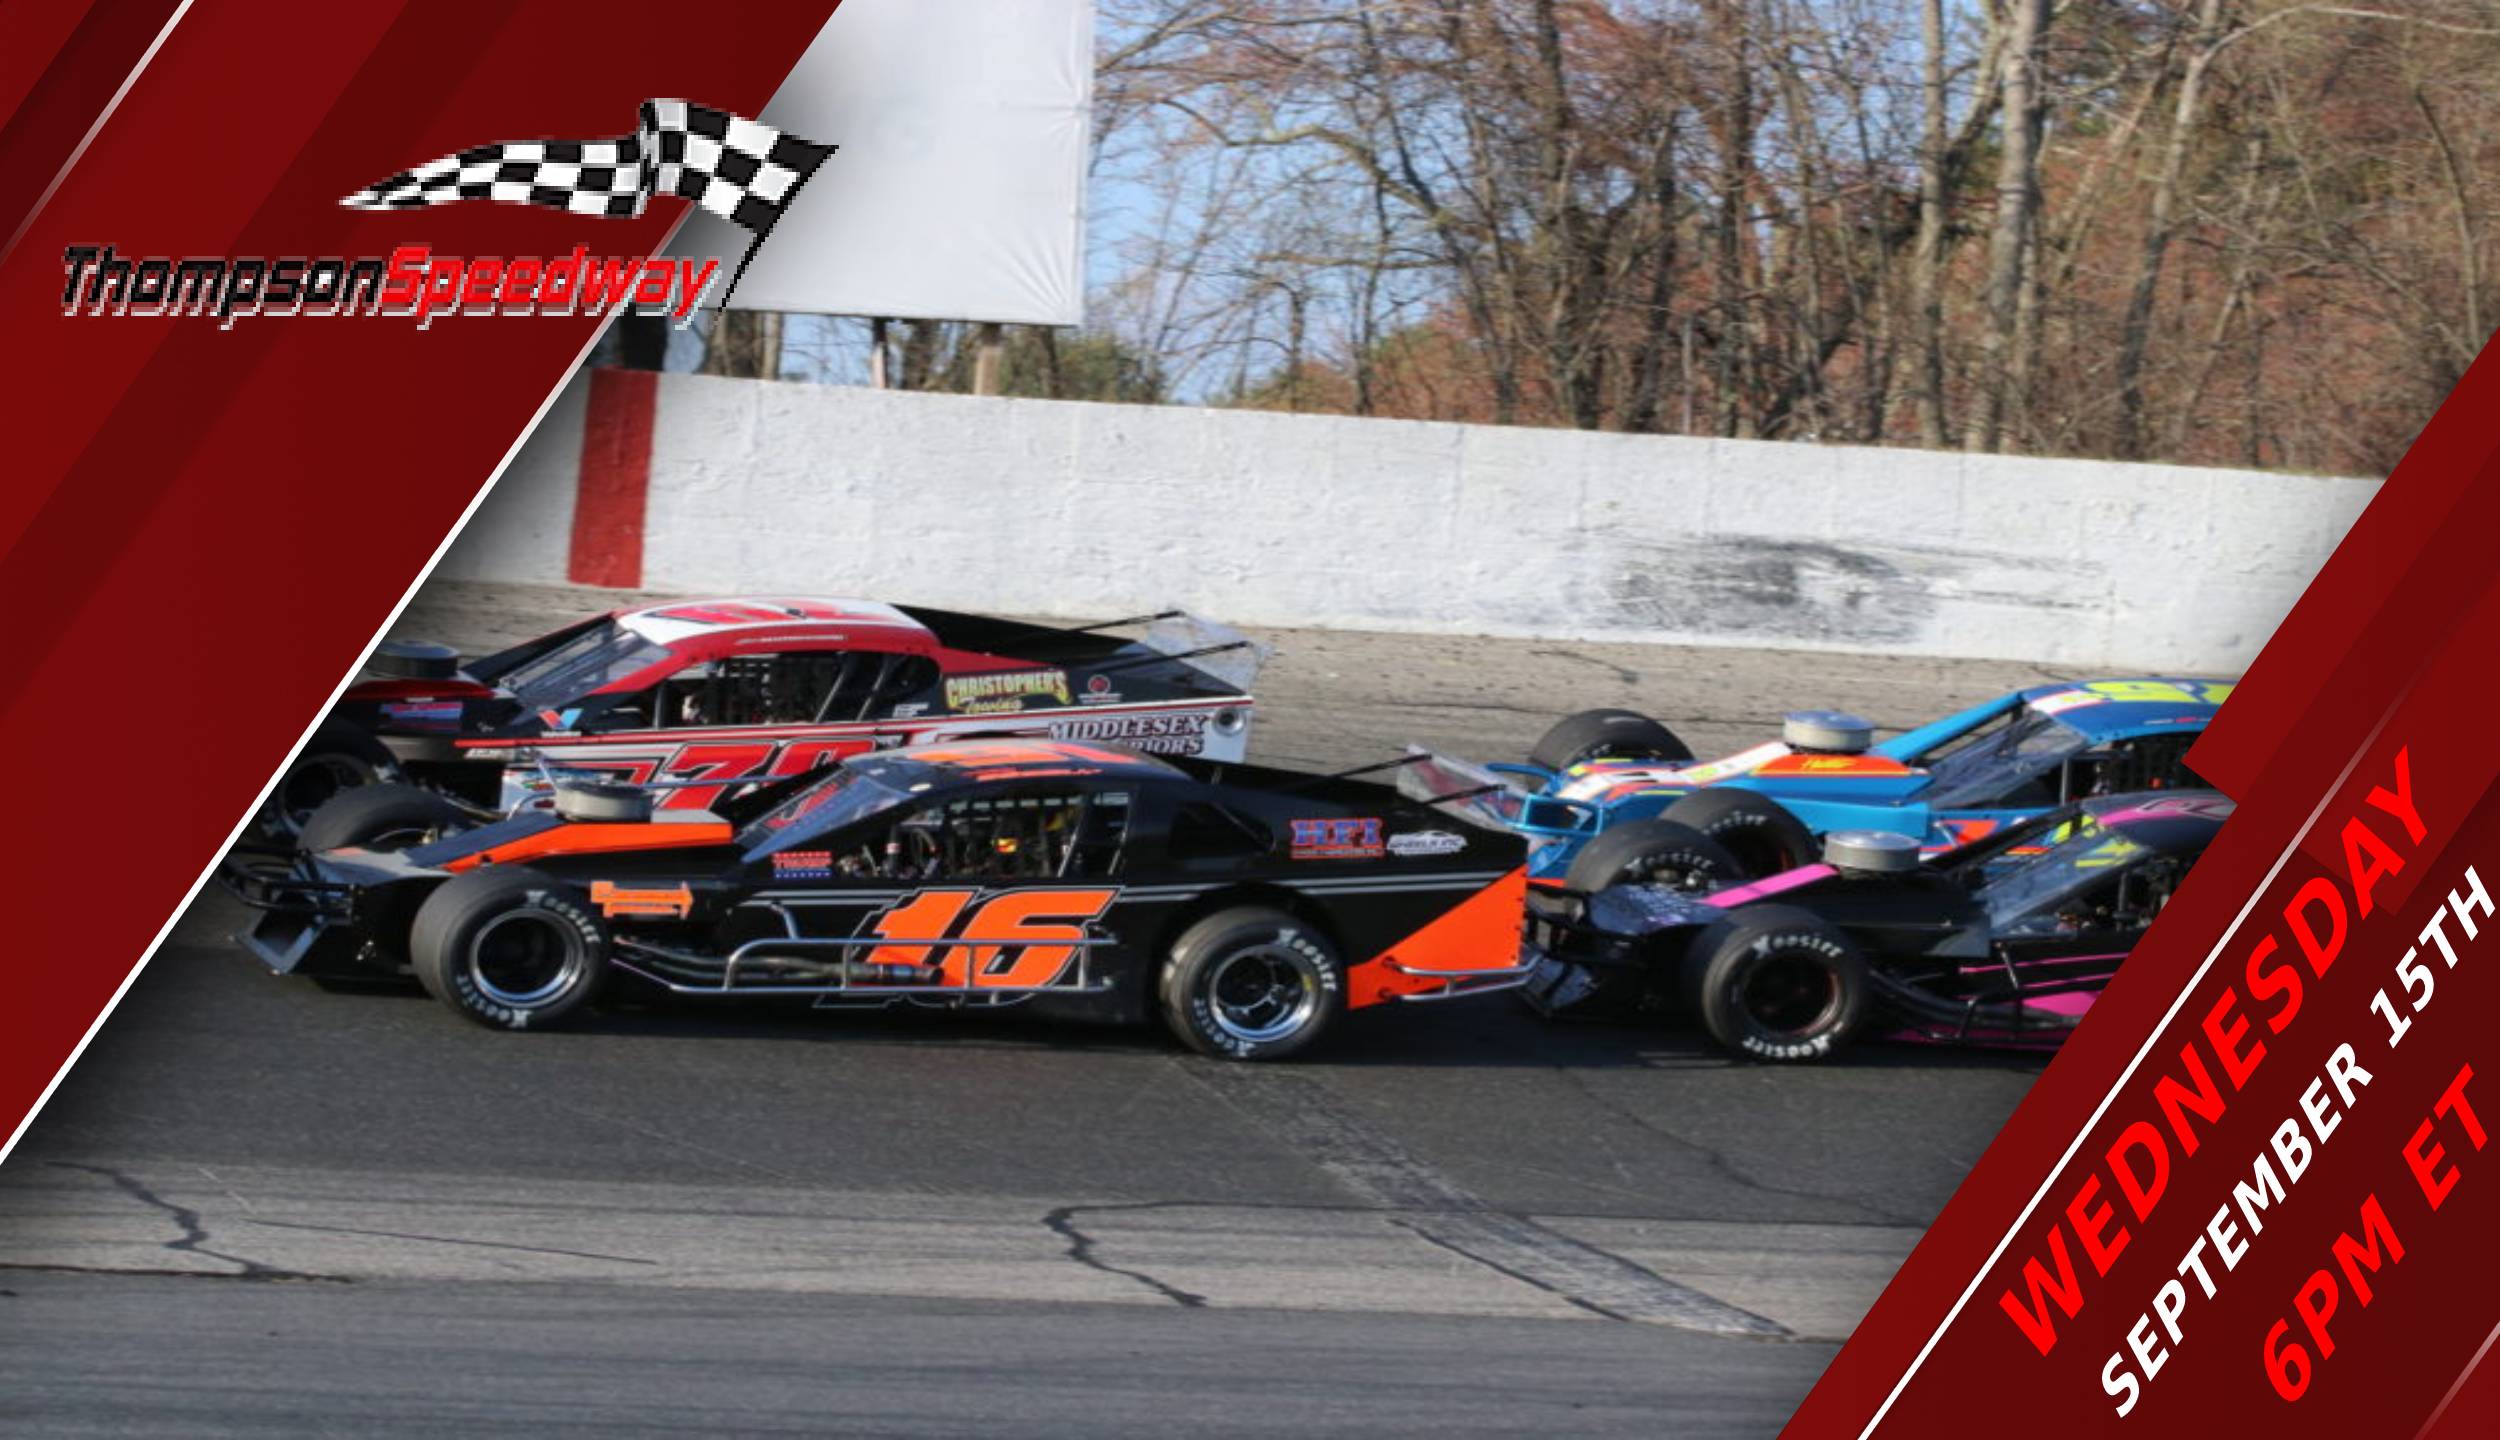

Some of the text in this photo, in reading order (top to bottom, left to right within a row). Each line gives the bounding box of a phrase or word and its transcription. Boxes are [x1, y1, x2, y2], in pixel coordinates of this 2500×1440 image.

[946, 670, 1072, 710] CHRISTOPHER'S
[1049, 714, 1206, 742] MIDDLESEX
[1292, 819, 1382, 846] HFI
[1701, 810, 1768, 835] oosier
[850, 887, 1123, 995] 16
[1752, 933, 1843, 958] Hoosier
